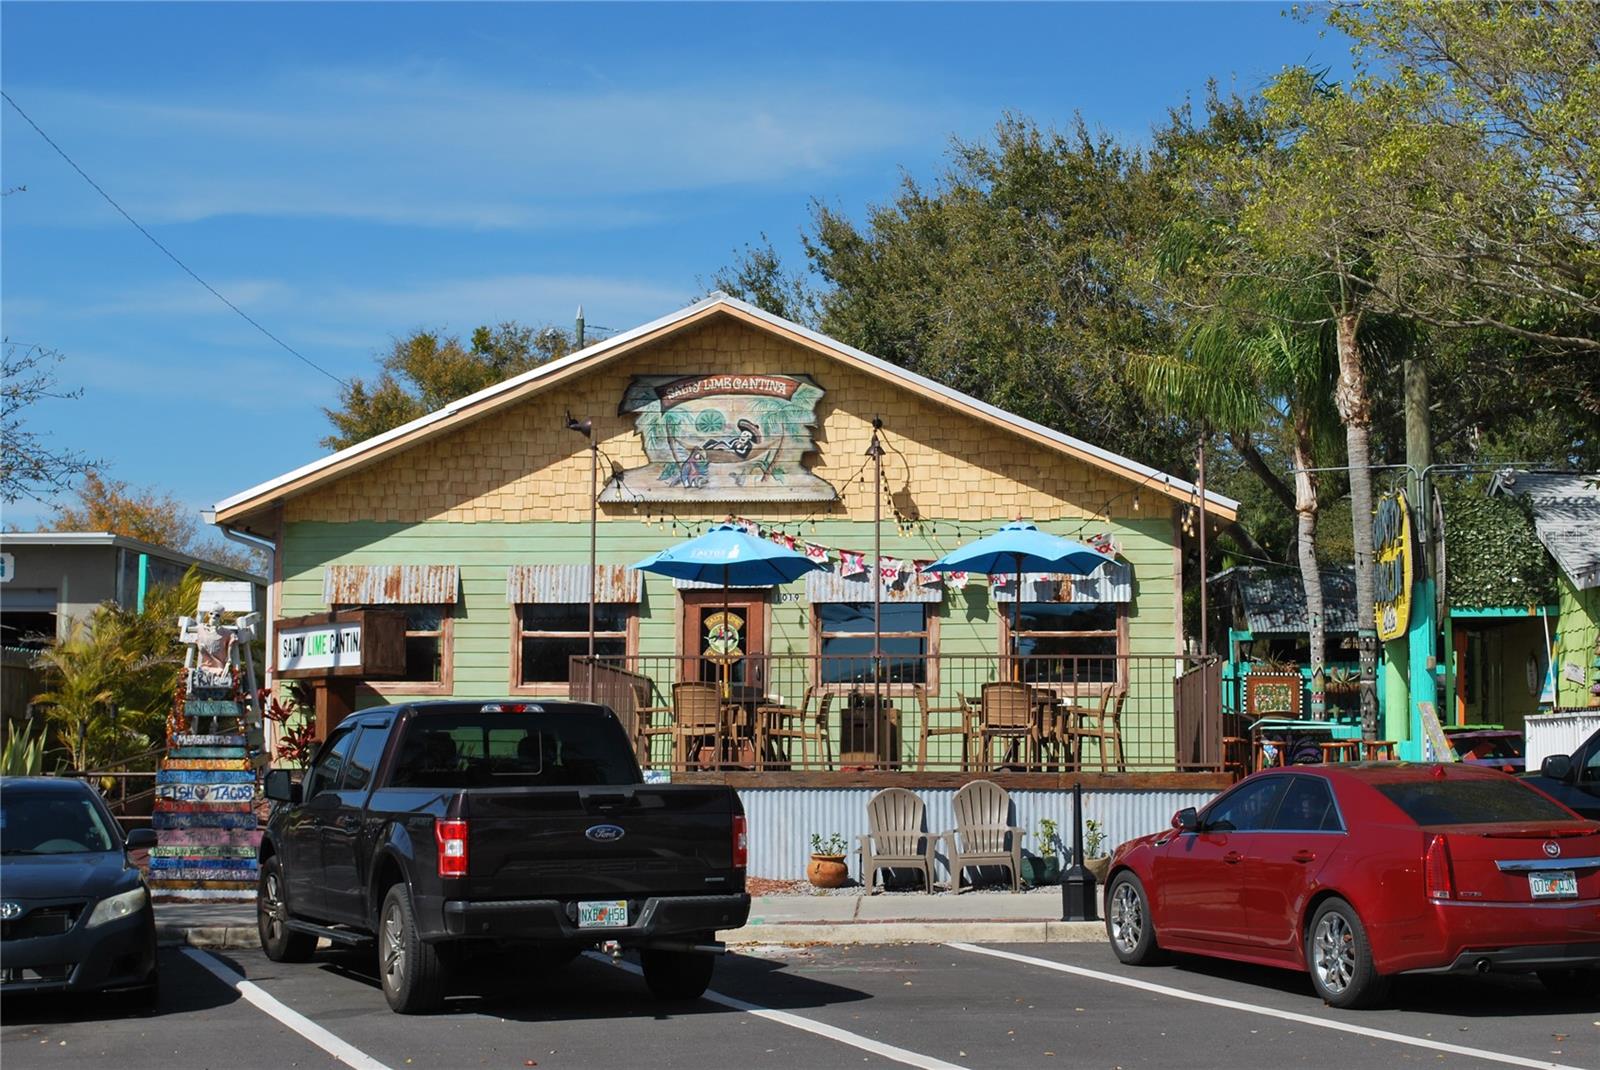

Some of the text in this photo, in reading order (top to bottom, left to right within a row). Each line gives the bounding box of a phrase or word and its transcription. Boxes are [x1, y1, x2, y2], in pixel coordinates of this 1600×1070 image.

[703, 377, 732, 392] LIME
[732, 377, 787, 396] CANTINA
[283, 636, 305, 658] SALTY
[307, 634, 328, 656] LIME
[160, 784, 254, 801] FISH TACOS
